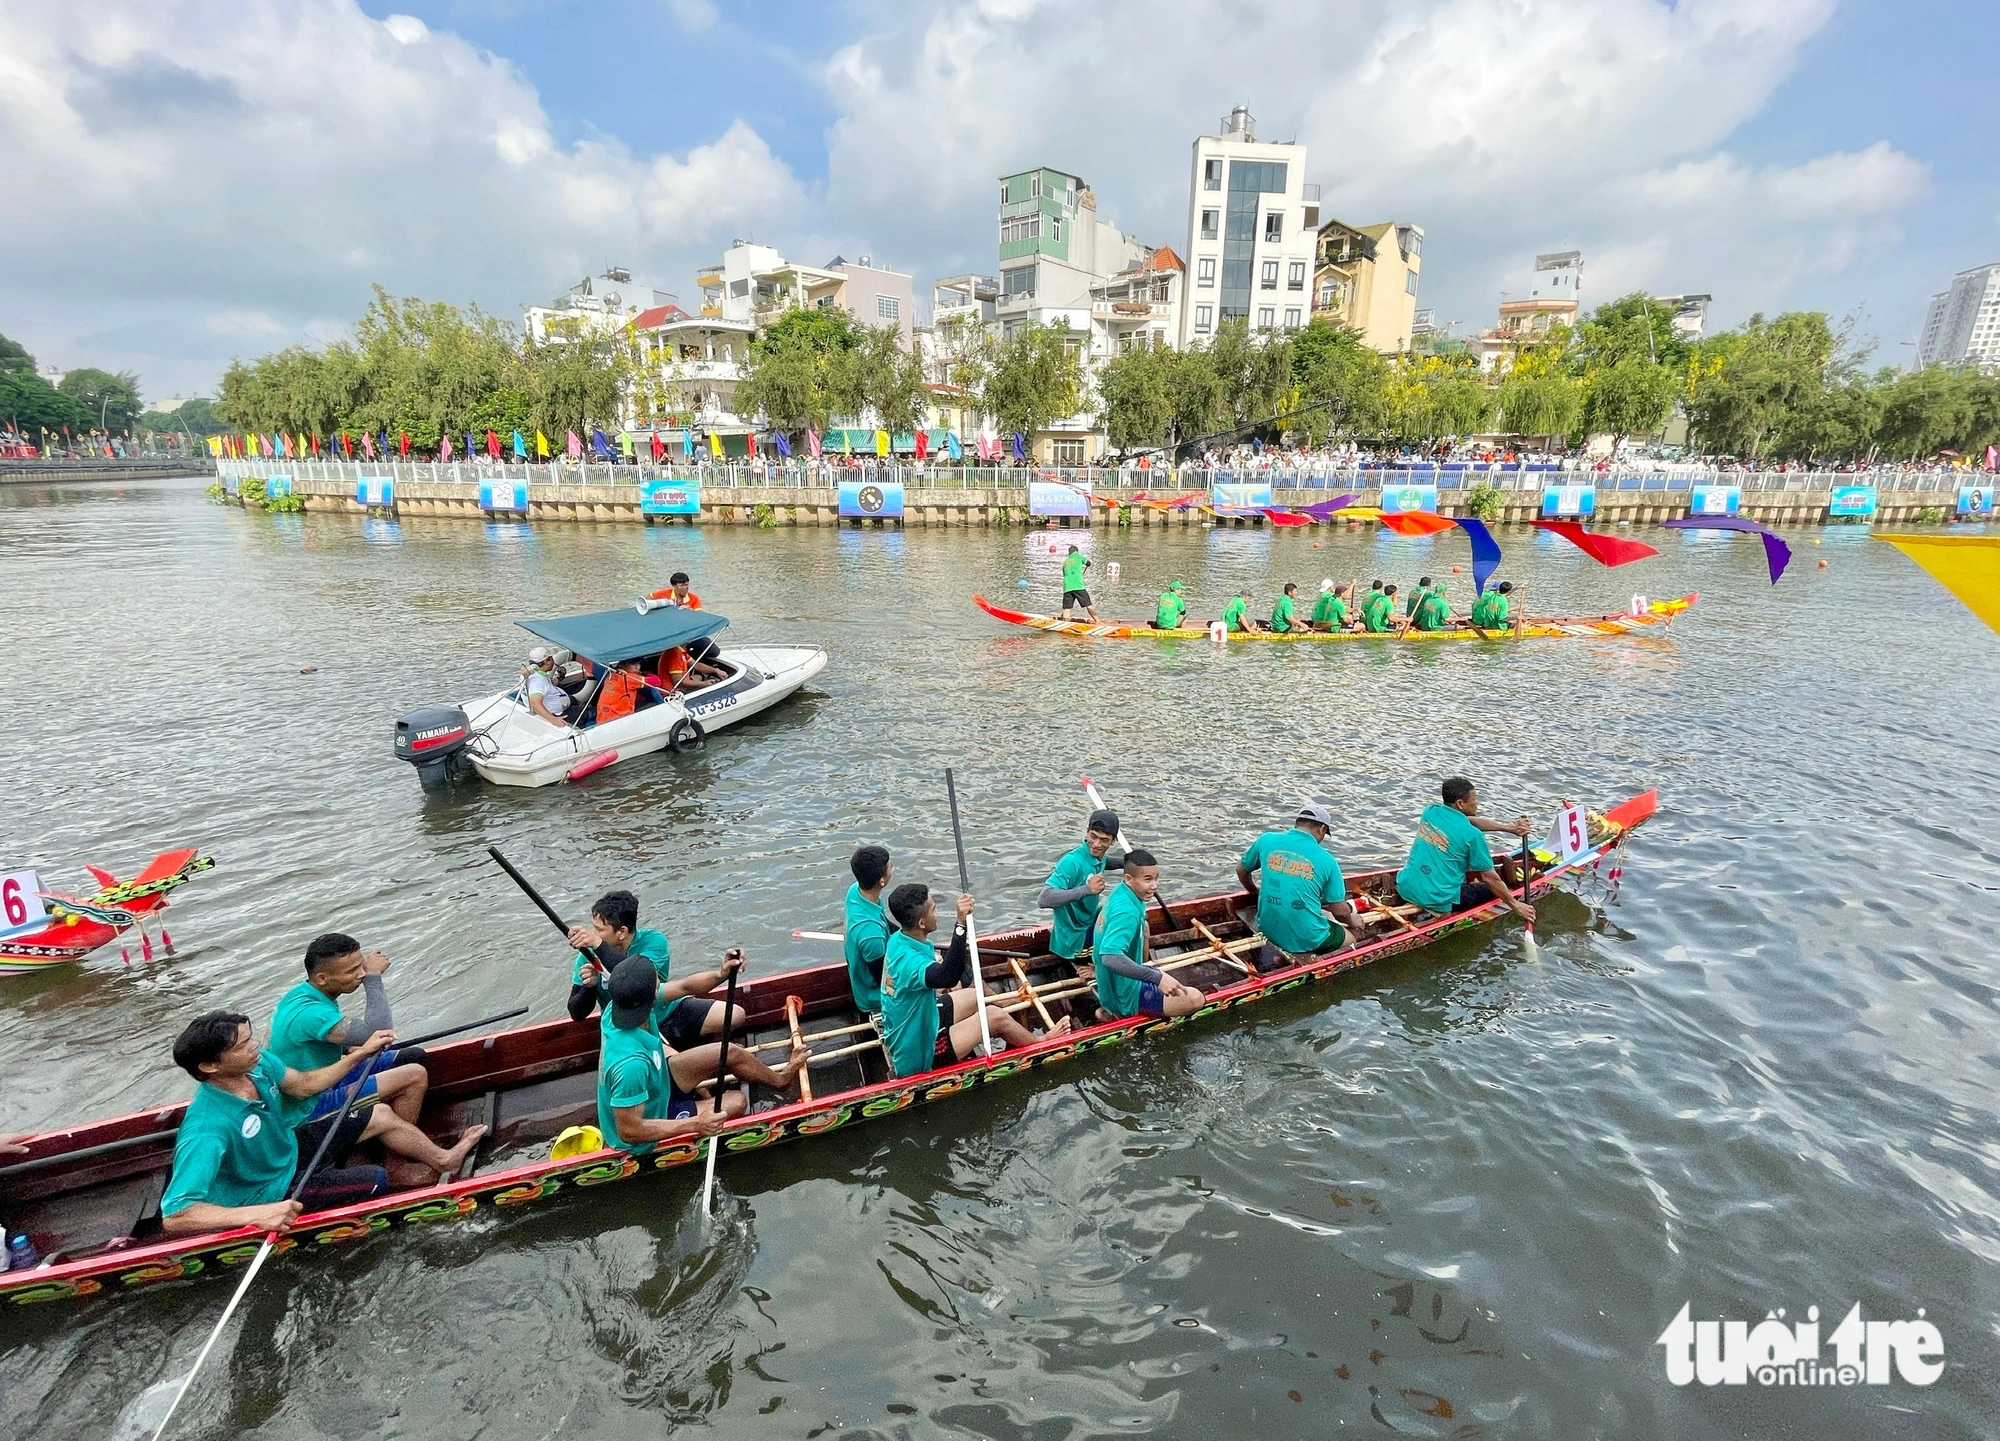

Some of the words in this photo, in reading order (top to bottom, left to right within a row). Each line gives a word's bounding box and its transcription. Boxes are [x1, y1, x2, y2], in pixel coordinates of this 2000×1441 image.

[1221, 488, 1265, 507] STC
[1215, 628, 1222, 641] 1
[416, 726, 450, 740] YAMAHA
[1568, 811, 1581, 852] 5
[3, 878, 27, 926] 6
